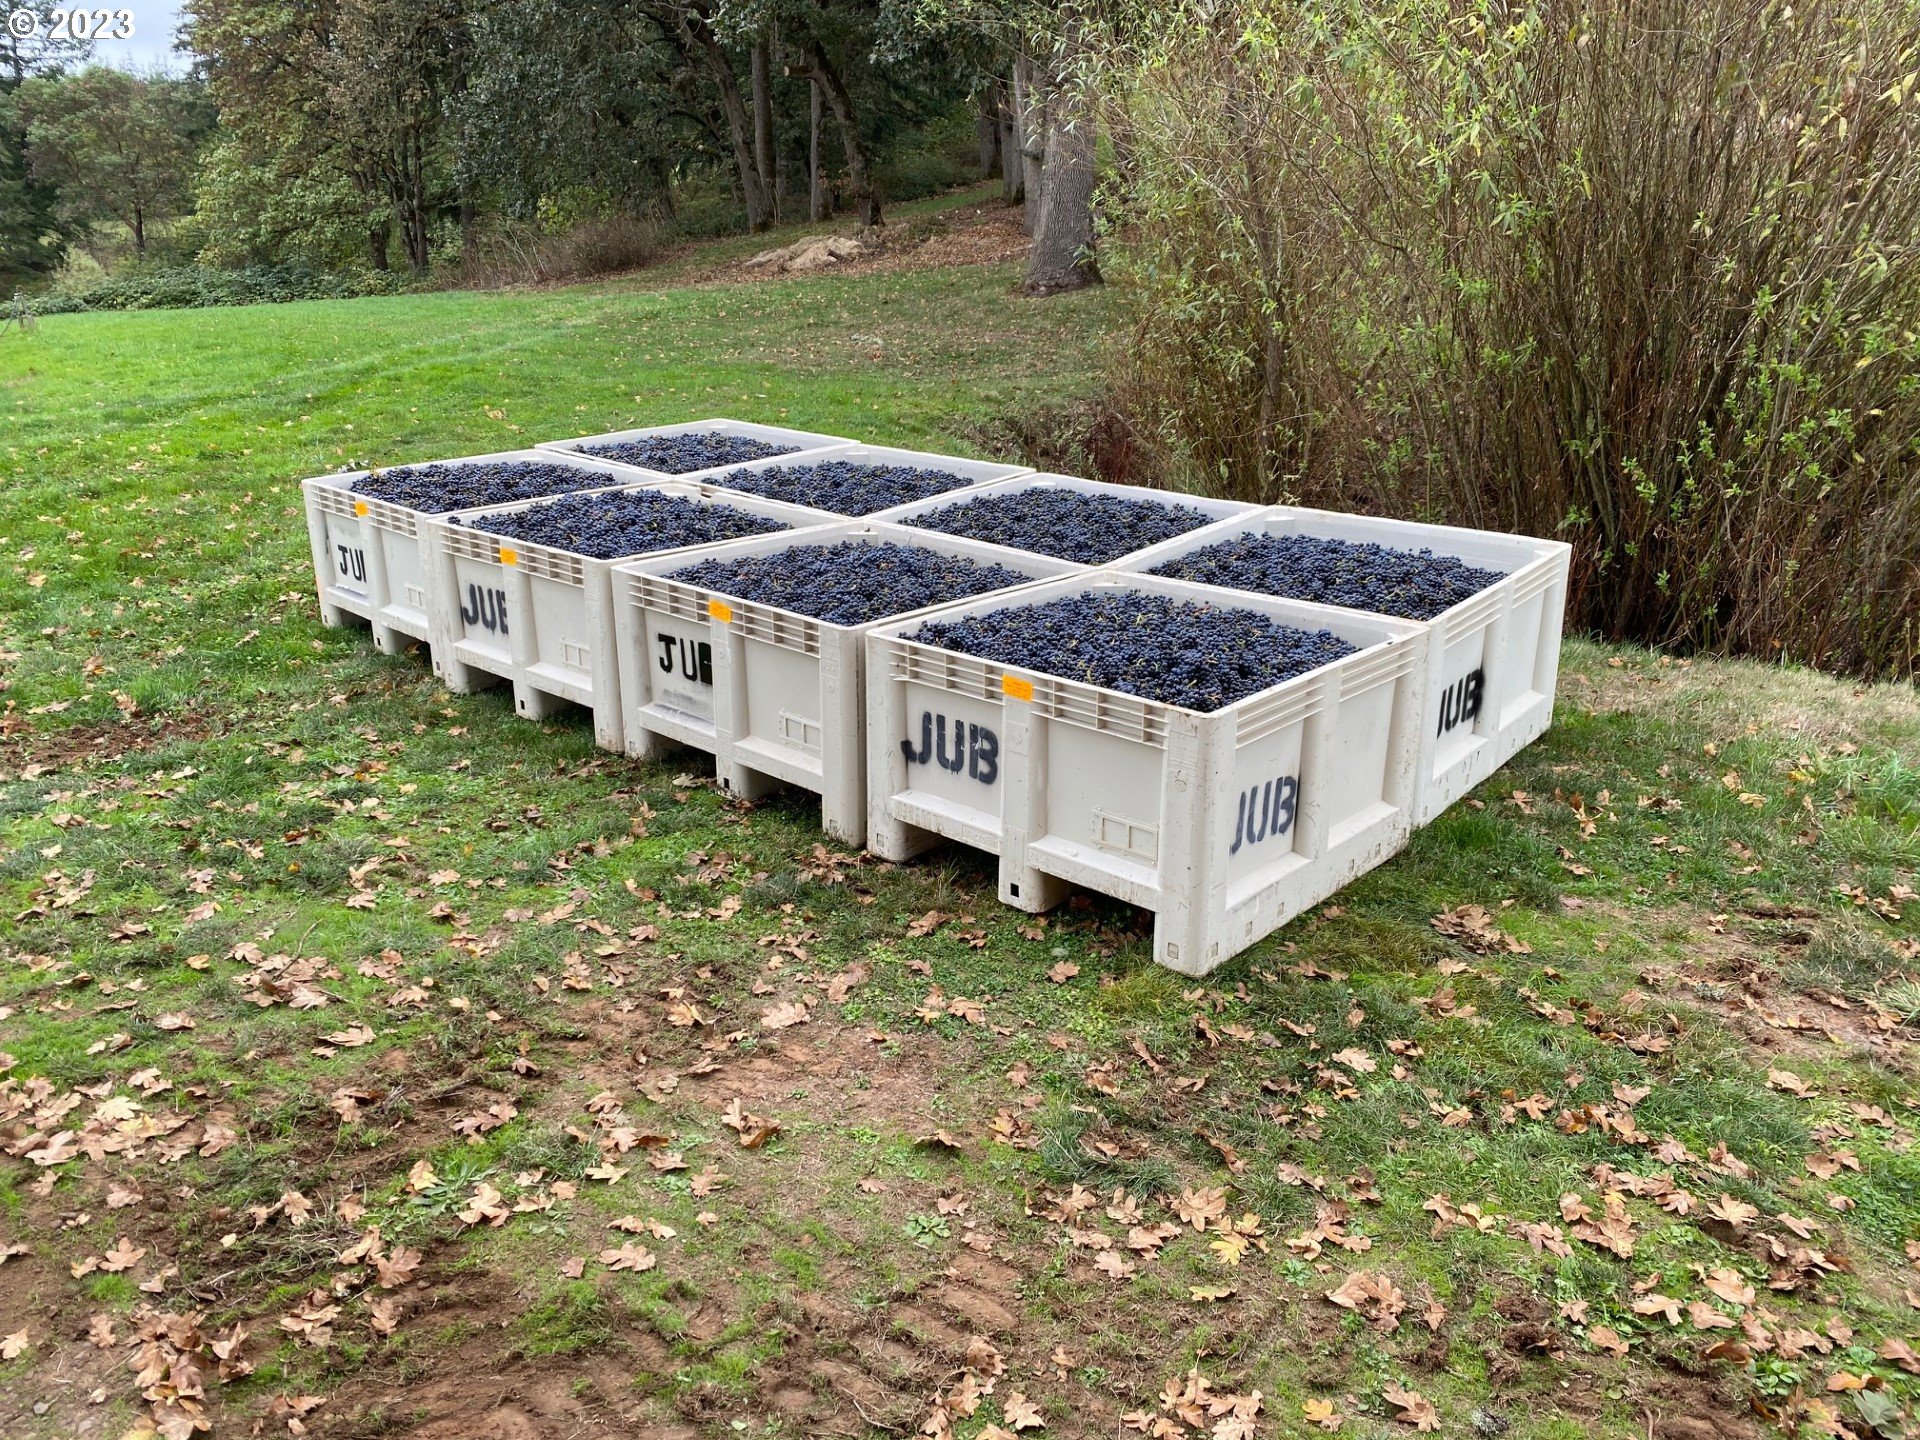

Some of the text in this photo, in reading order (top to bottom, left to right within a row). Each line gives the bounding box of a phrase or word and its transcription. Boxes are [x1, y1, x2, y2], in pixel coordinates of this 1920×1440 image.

[337, 544, 367, 583] JU
[1437, 667, 1485, 739] JUB
[901, 711, 998, 785] JUB
[1231, 776, 1297, 855] JUB
